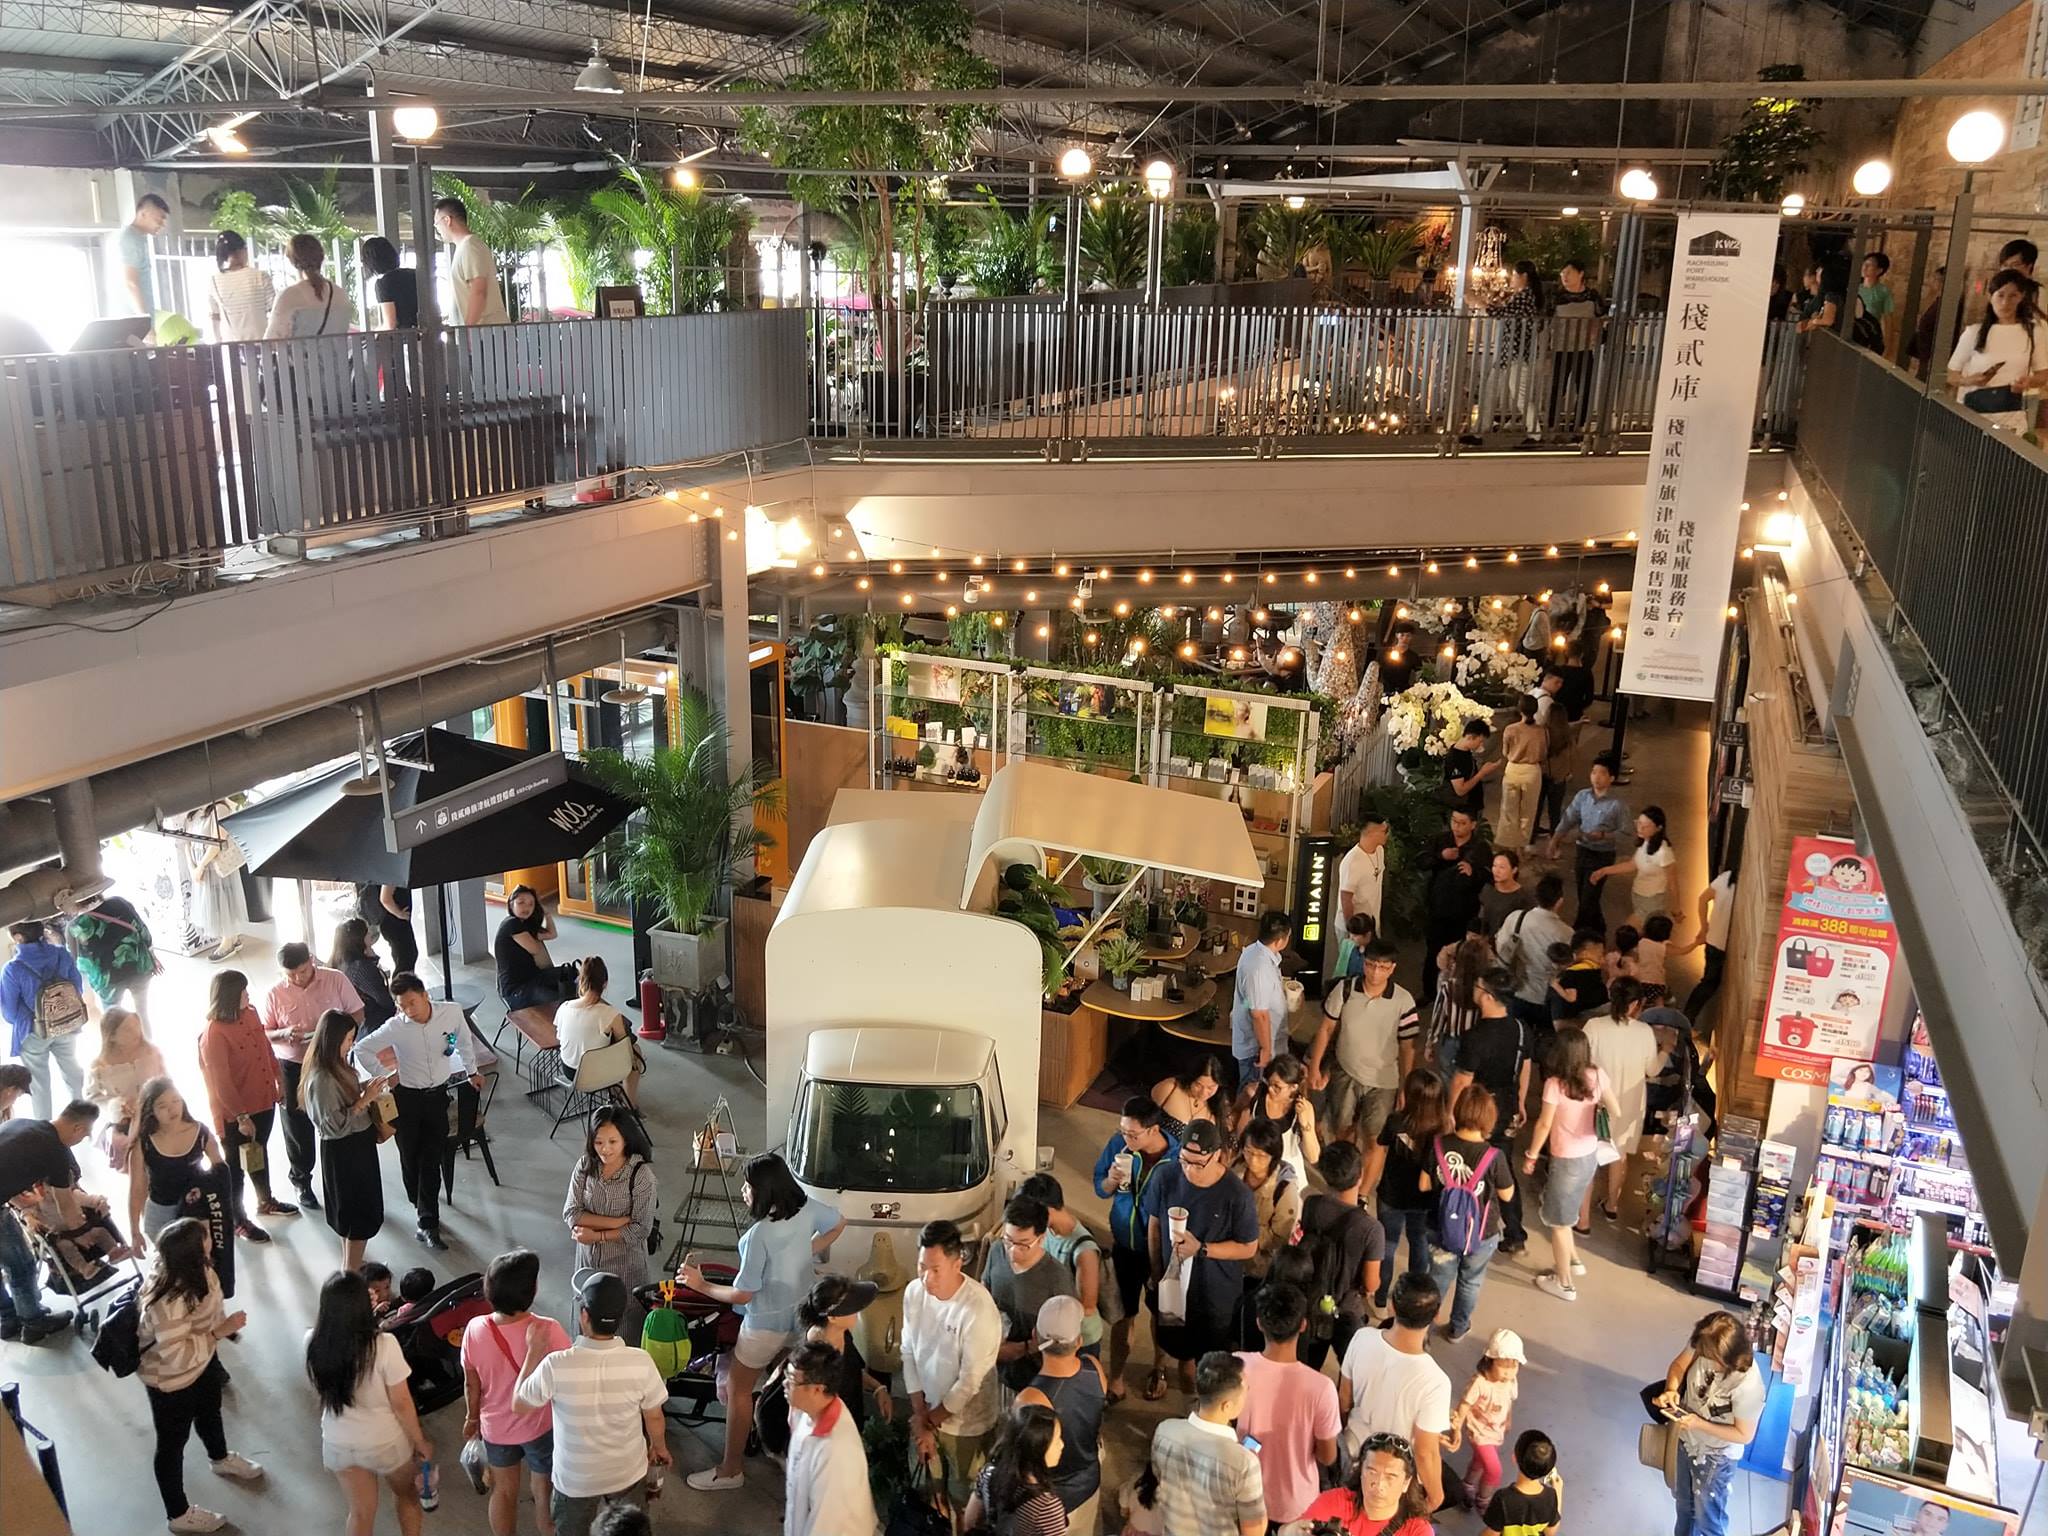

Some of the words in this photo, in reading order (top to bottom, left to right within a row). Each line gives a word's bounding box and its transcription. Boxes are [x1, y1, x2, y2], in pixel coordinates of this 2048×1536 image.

[1670, 303, 1710, 402] 棧貳庫
[1642, 418, 1685, 622] 棧貳庫旗津航線售票處
[1667, 520, 1696, 623] 棧貳庫服務台
[1307, 856, 1325, 924] THANN
[1781, 1066, 1829, 1082] COSM
